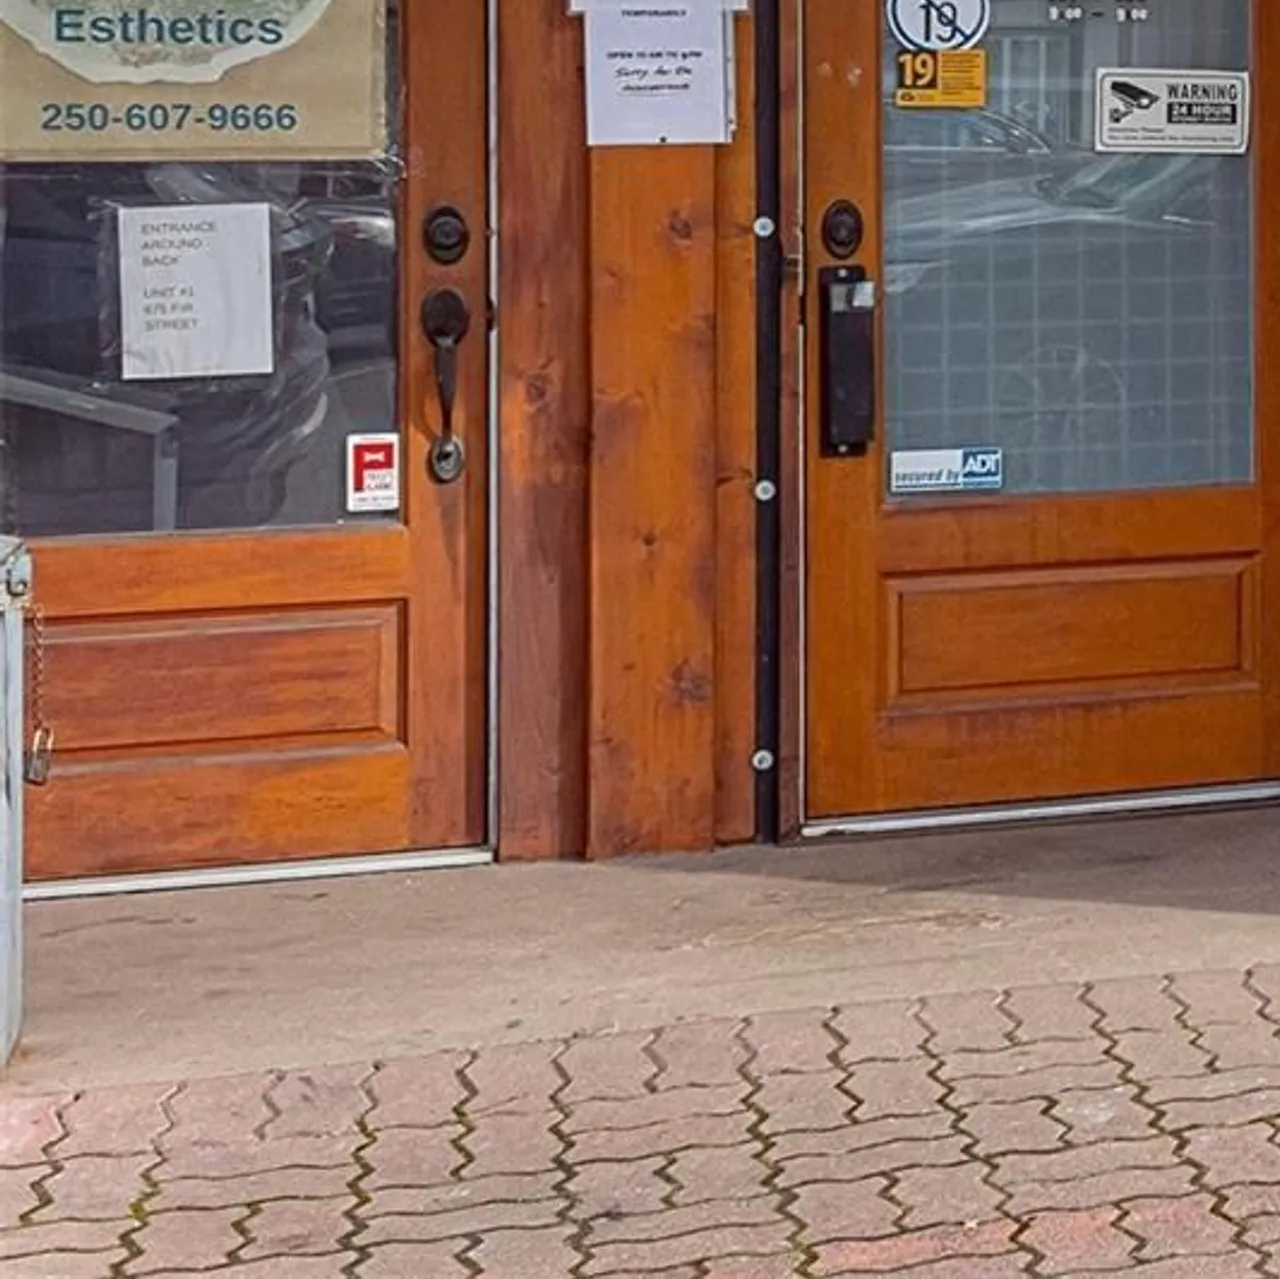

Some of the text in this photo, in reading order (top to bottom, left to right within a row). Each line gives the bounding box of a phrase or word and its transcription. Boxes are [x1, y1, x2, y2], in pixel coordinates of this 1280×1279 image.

[54, 9, 284, 46] Esthetics
[920, 2, 957, 43] 19
[897, 52, 935, 87] 19
[1167, 84, 1238, 101] WARNING
[41, 102, 298, 132] 250-607-9666
[141, 221, 216, 235] ENTRANCE
[142, 238, 204, 251] AROUND
[142, 255, 180, 267] BACK
[145, 318, 199, 332] STREET
[964, 452, 1000, 475] ADT
